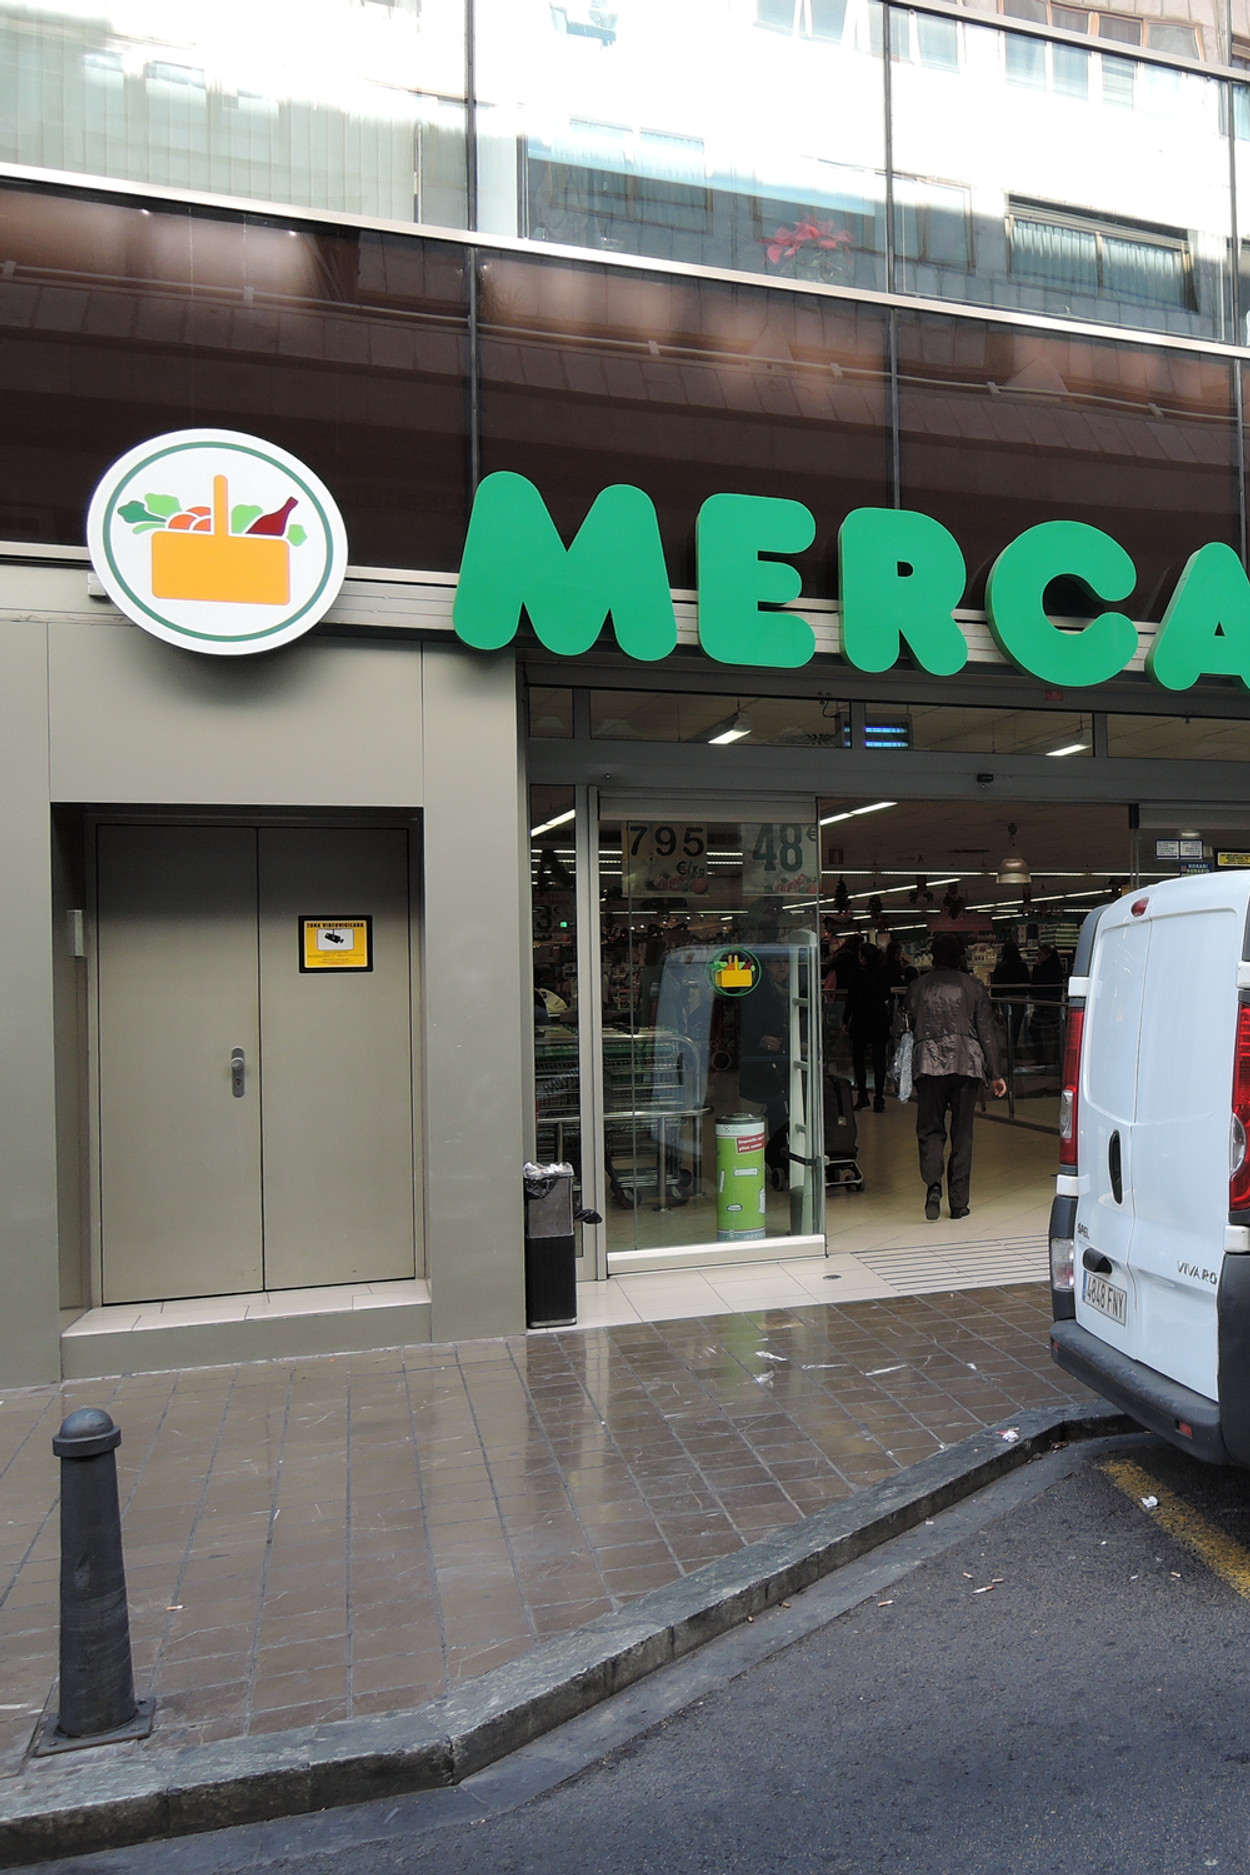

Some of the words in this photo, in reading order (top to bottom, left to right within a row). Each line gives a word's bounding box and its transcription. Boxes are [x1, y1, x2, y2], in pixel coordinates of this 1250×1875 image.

[1177, 1260, 1218, 1285] VIVARO
[1086, 1275, 1106, 1310] 4848
[1107, 1287, 1124, 1319] FNY
